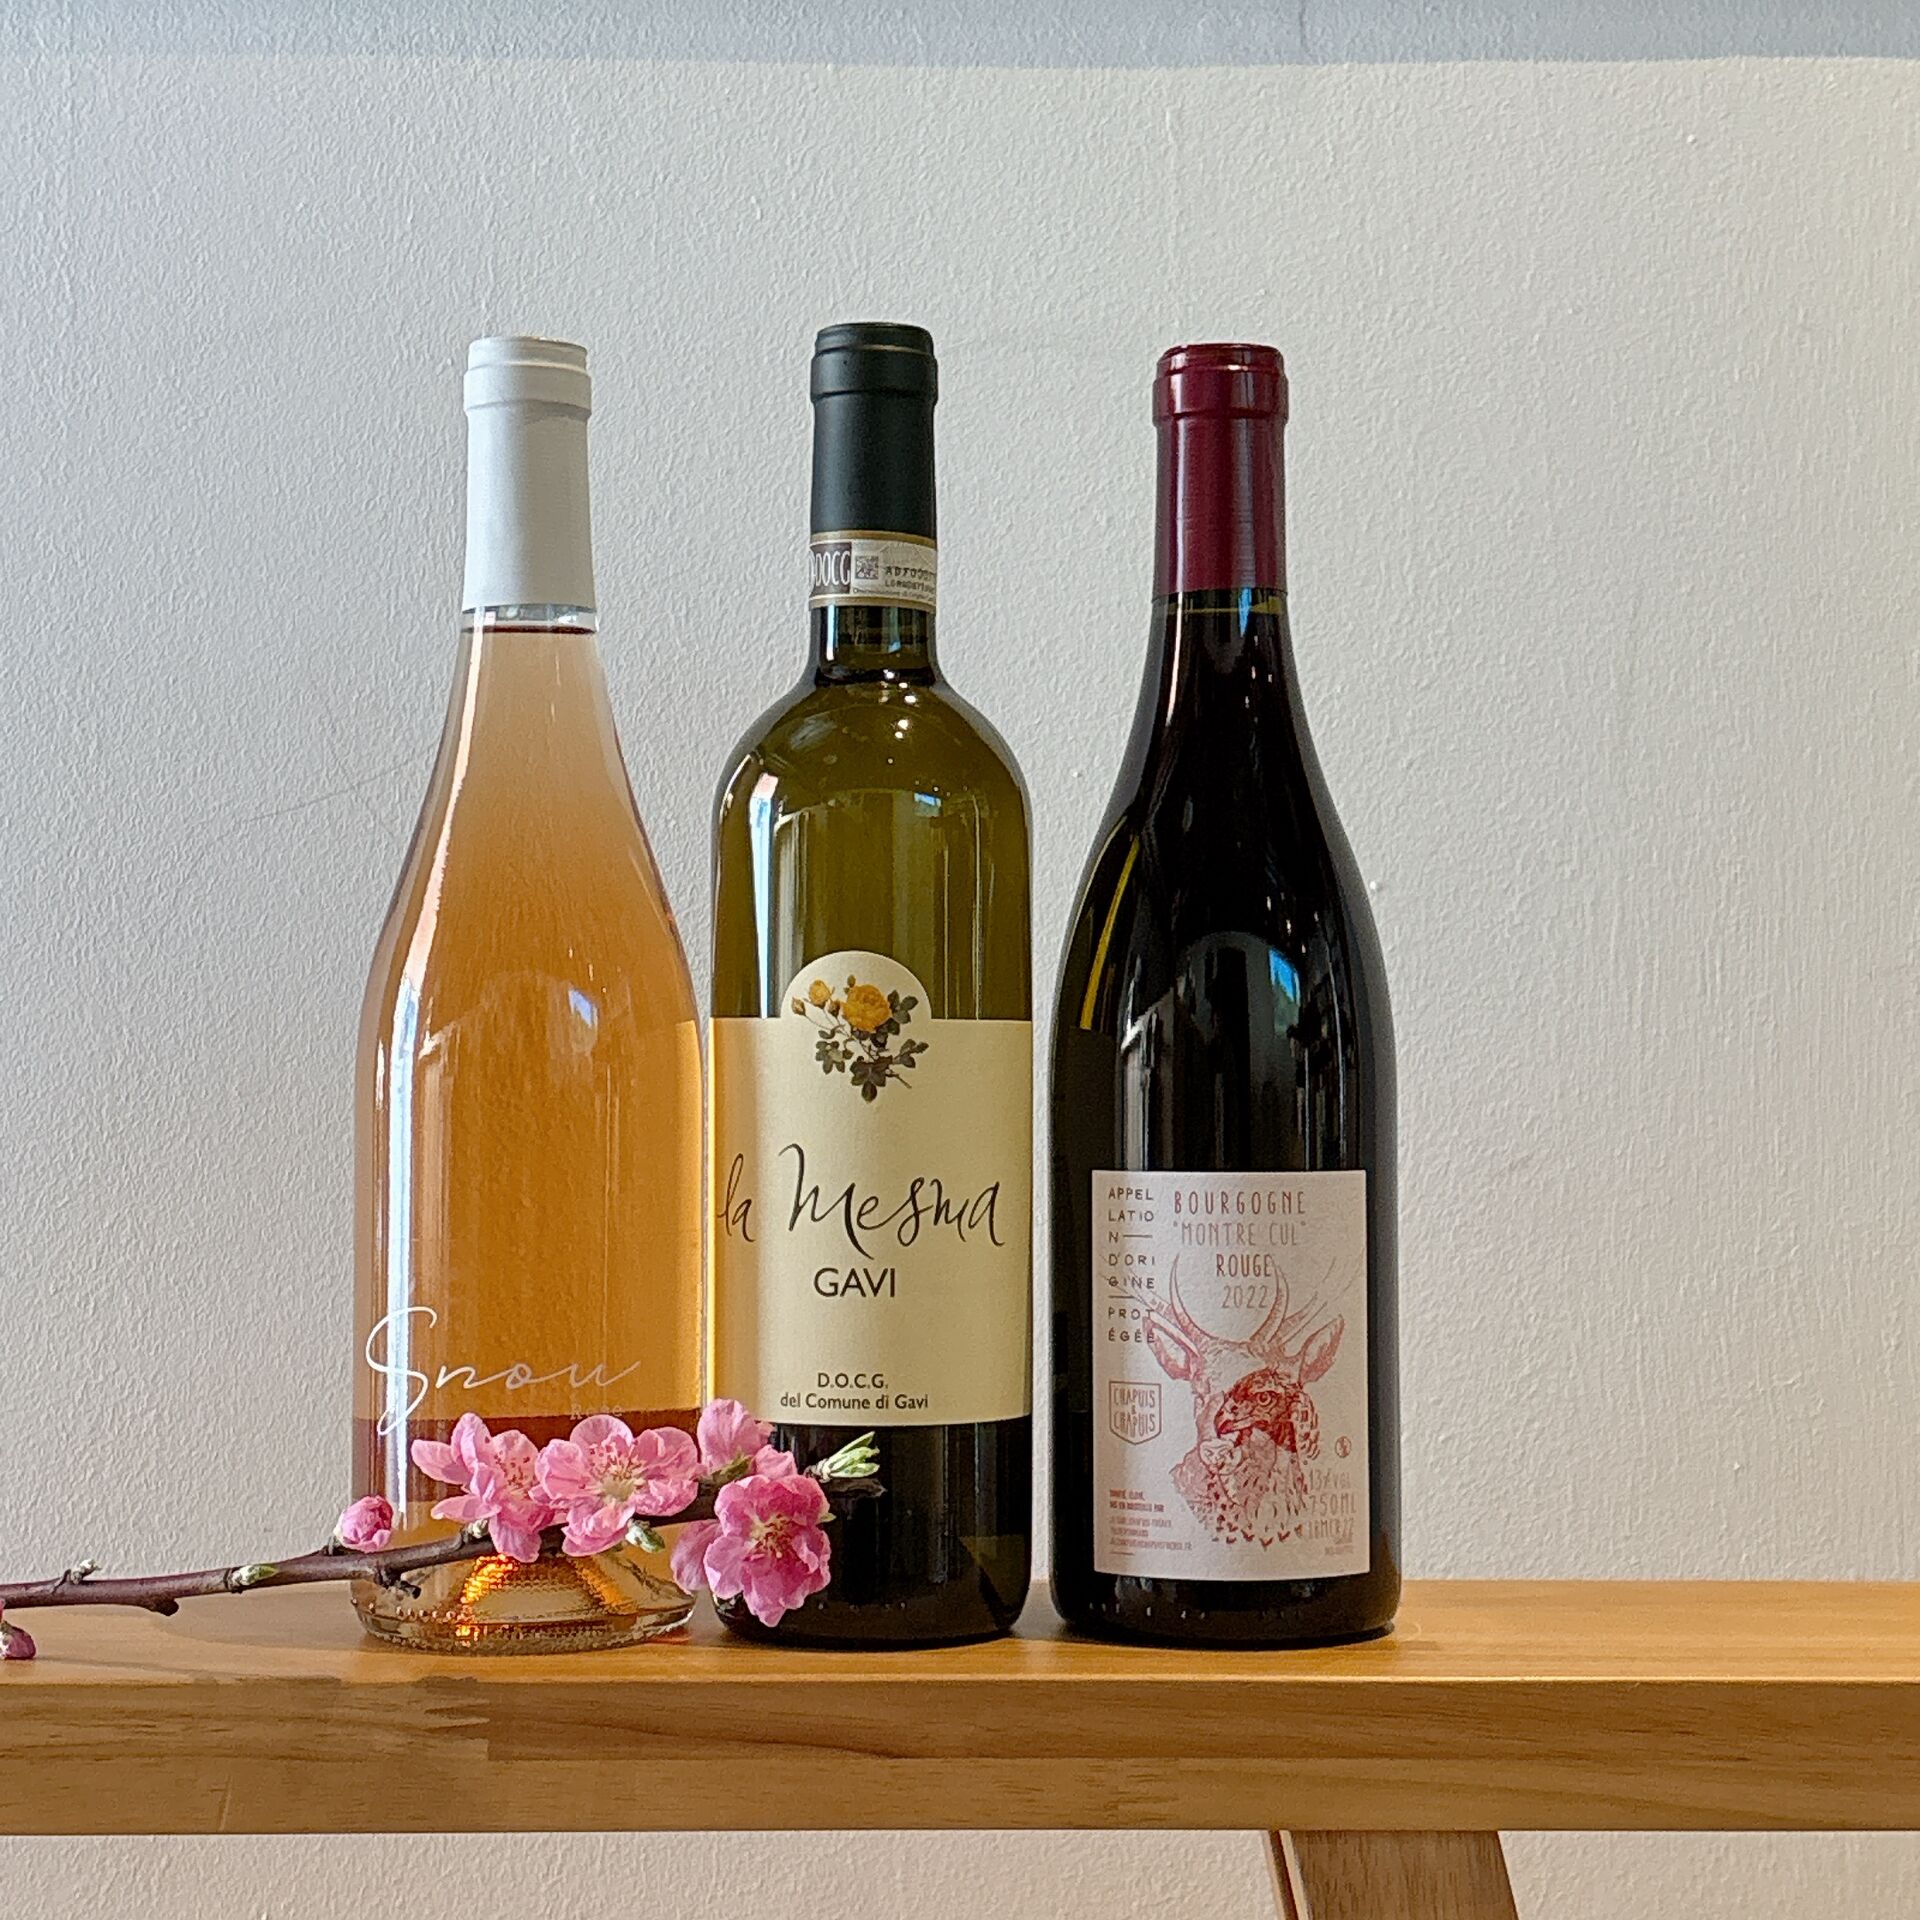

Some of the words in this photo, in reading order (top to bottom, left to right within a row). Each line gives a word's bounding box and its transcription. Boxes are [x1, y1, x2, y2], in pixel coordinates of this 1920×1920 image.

[816, 551, 850, 586] DOCG
[716, 1153, 756, 1242] la
[778, 1143, 1006, 1260] Mesma
[1108, 1187, 1154, 1200] APPEL
[1174, 1190, 1306, 1215] BOURGOGNE
[1108, 1211, 1154, 1222] LATIO
[1108, 1253, 1155, 1266] D'ORI
[1216, 1253, 1274, 1277] ROUGE
[813, 1268, 896, 1297] GAVI
[1108, 1277, 1155, 1289] GINE
[1221, 1285, 1269, 1309] 2022
[1108, 1308, 1155, 1320] PROT
[365, 1306, 641, 1436] Snow
[817, 1372, 889, 1389] D.O.C.G.
[780, 1392, 801, 1408] del
[805, 1393, 871, 1409] Comune
[875, 1394, 889, 1409] di
[894, 1394, 929, 1409] Gavi
